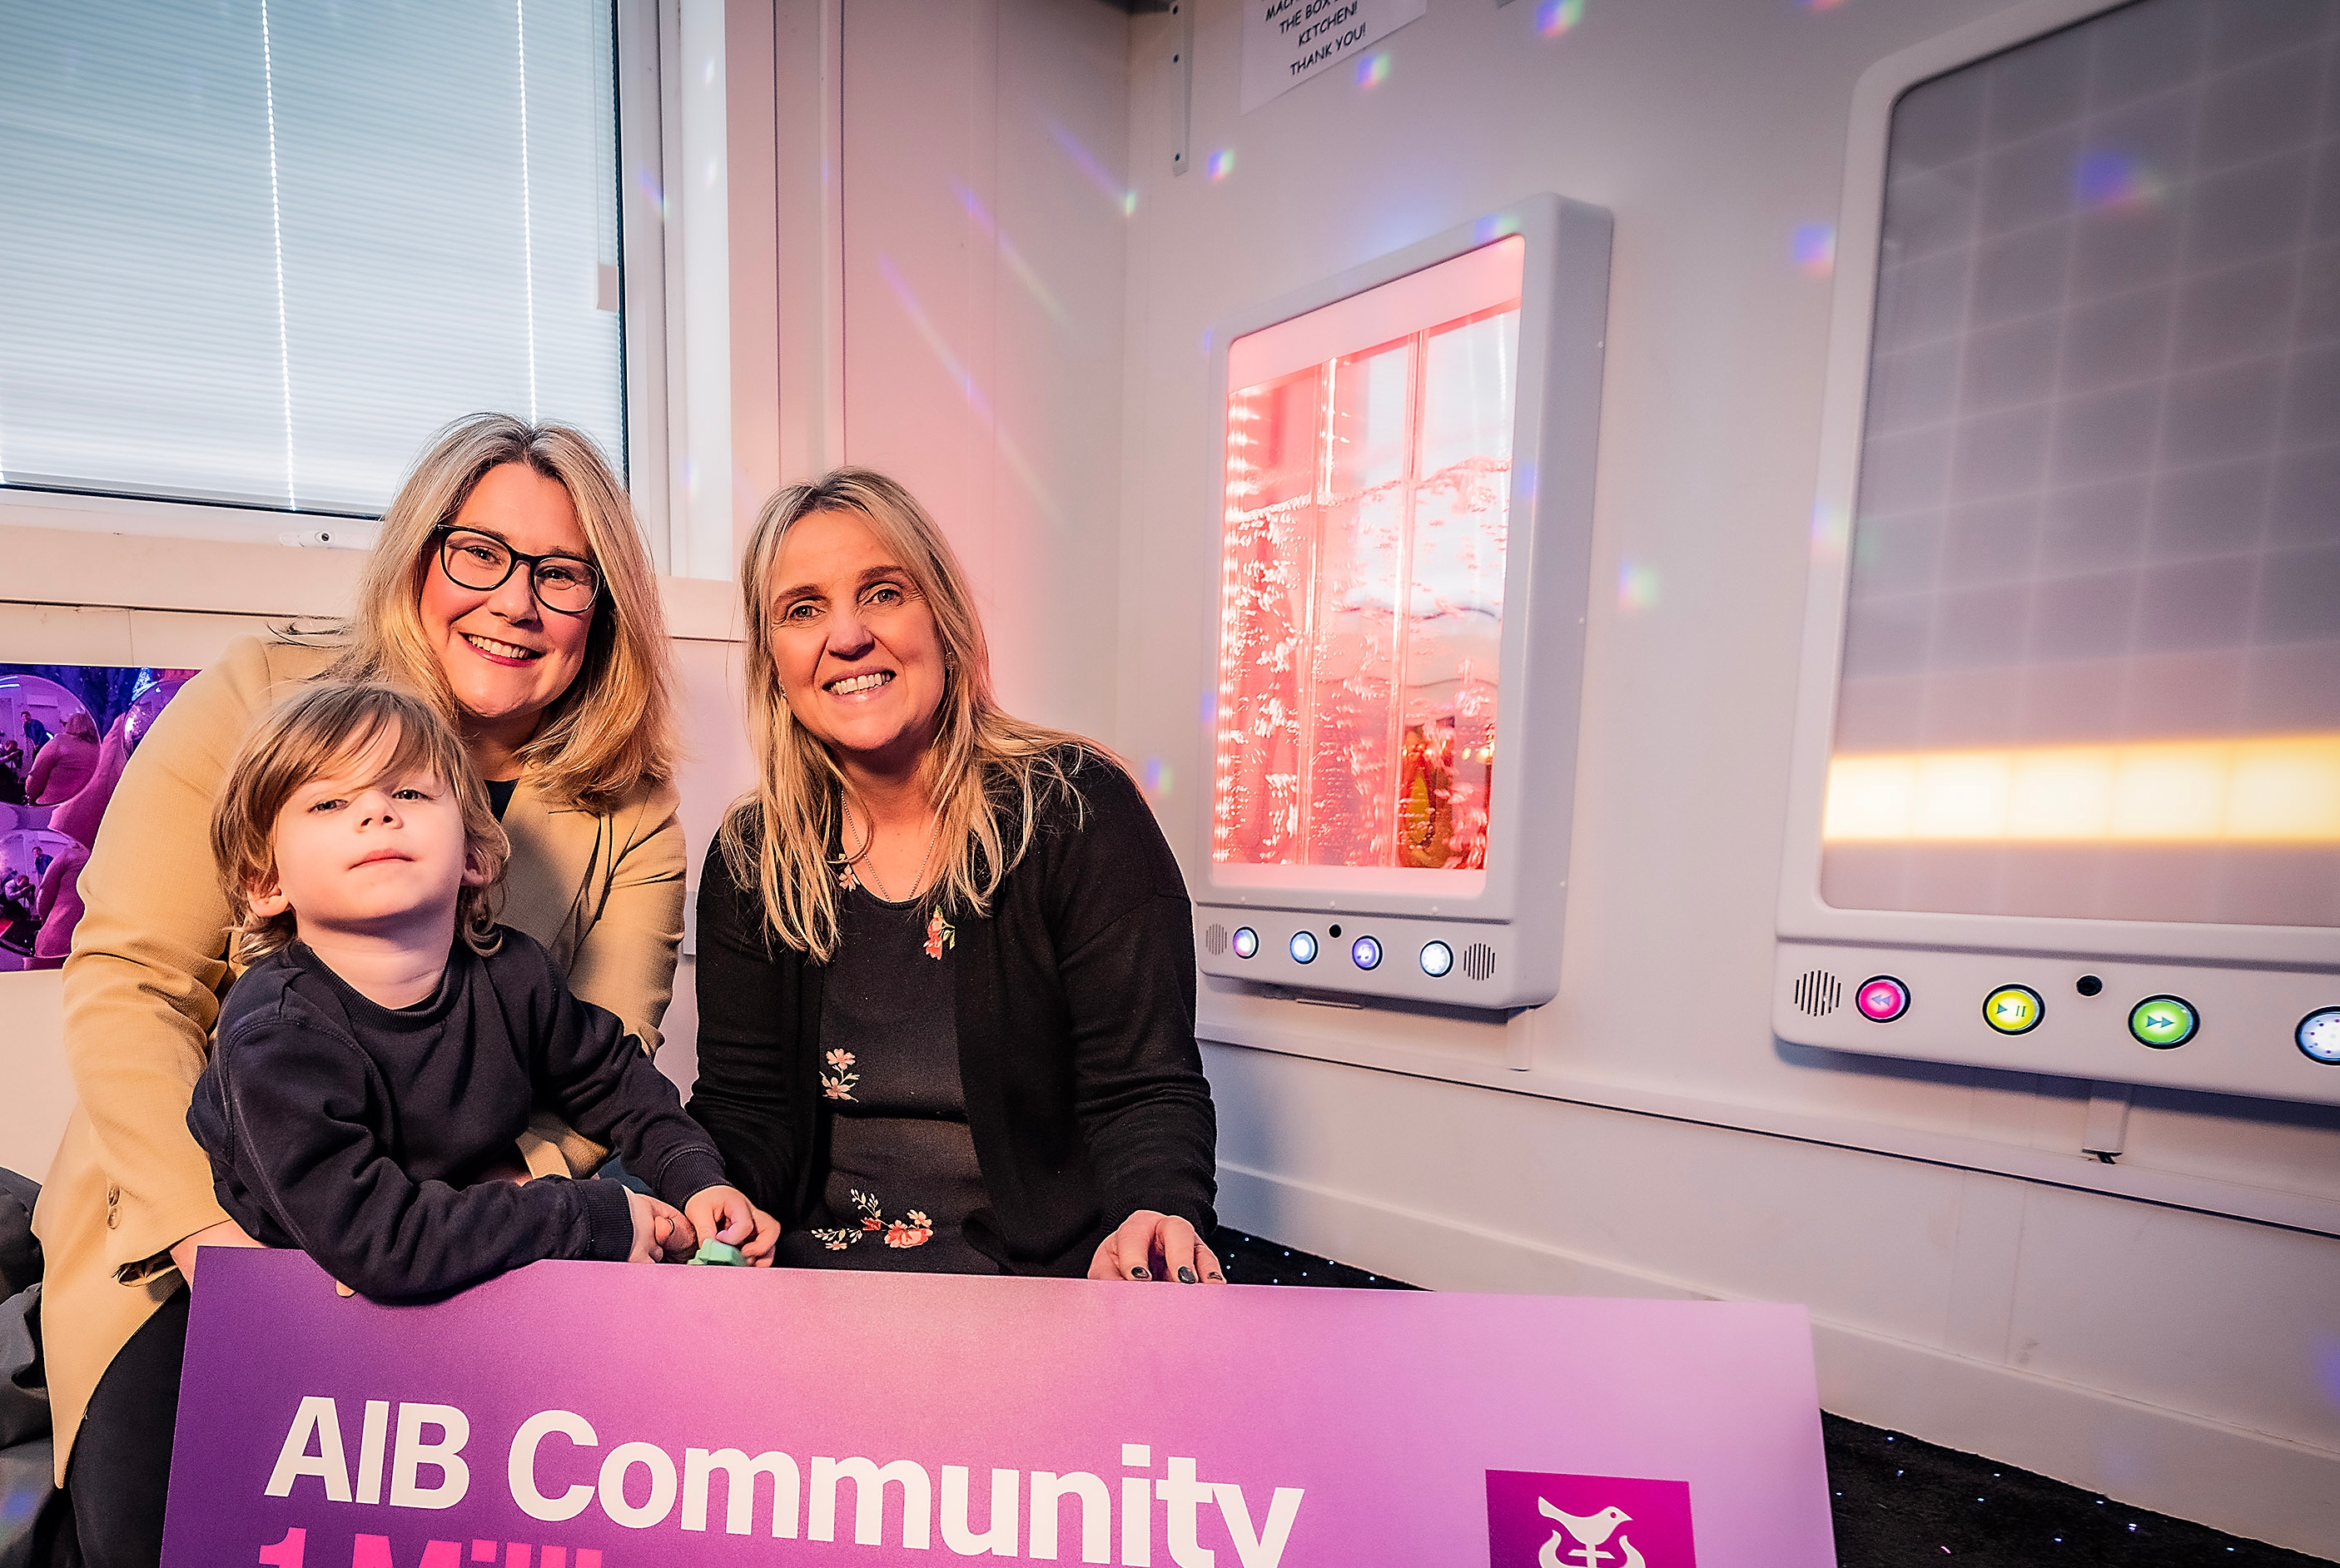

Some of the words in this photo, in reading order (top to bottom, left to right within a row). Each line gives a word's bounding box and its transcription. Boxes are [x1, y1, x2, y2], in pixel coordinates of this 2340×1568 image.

[1279, 9, 1302, 33] THE
[1305, 0, 1330, 19] BOX
[1299, 1, 1358, 47] KITCHEN!
[1290, 42, 1332, 75] THANK
[1335, 22, 1366, 51] YOU!
[264, 1396, 470, 1510] AIB
[508, 1409, 1305, 1568] Community
